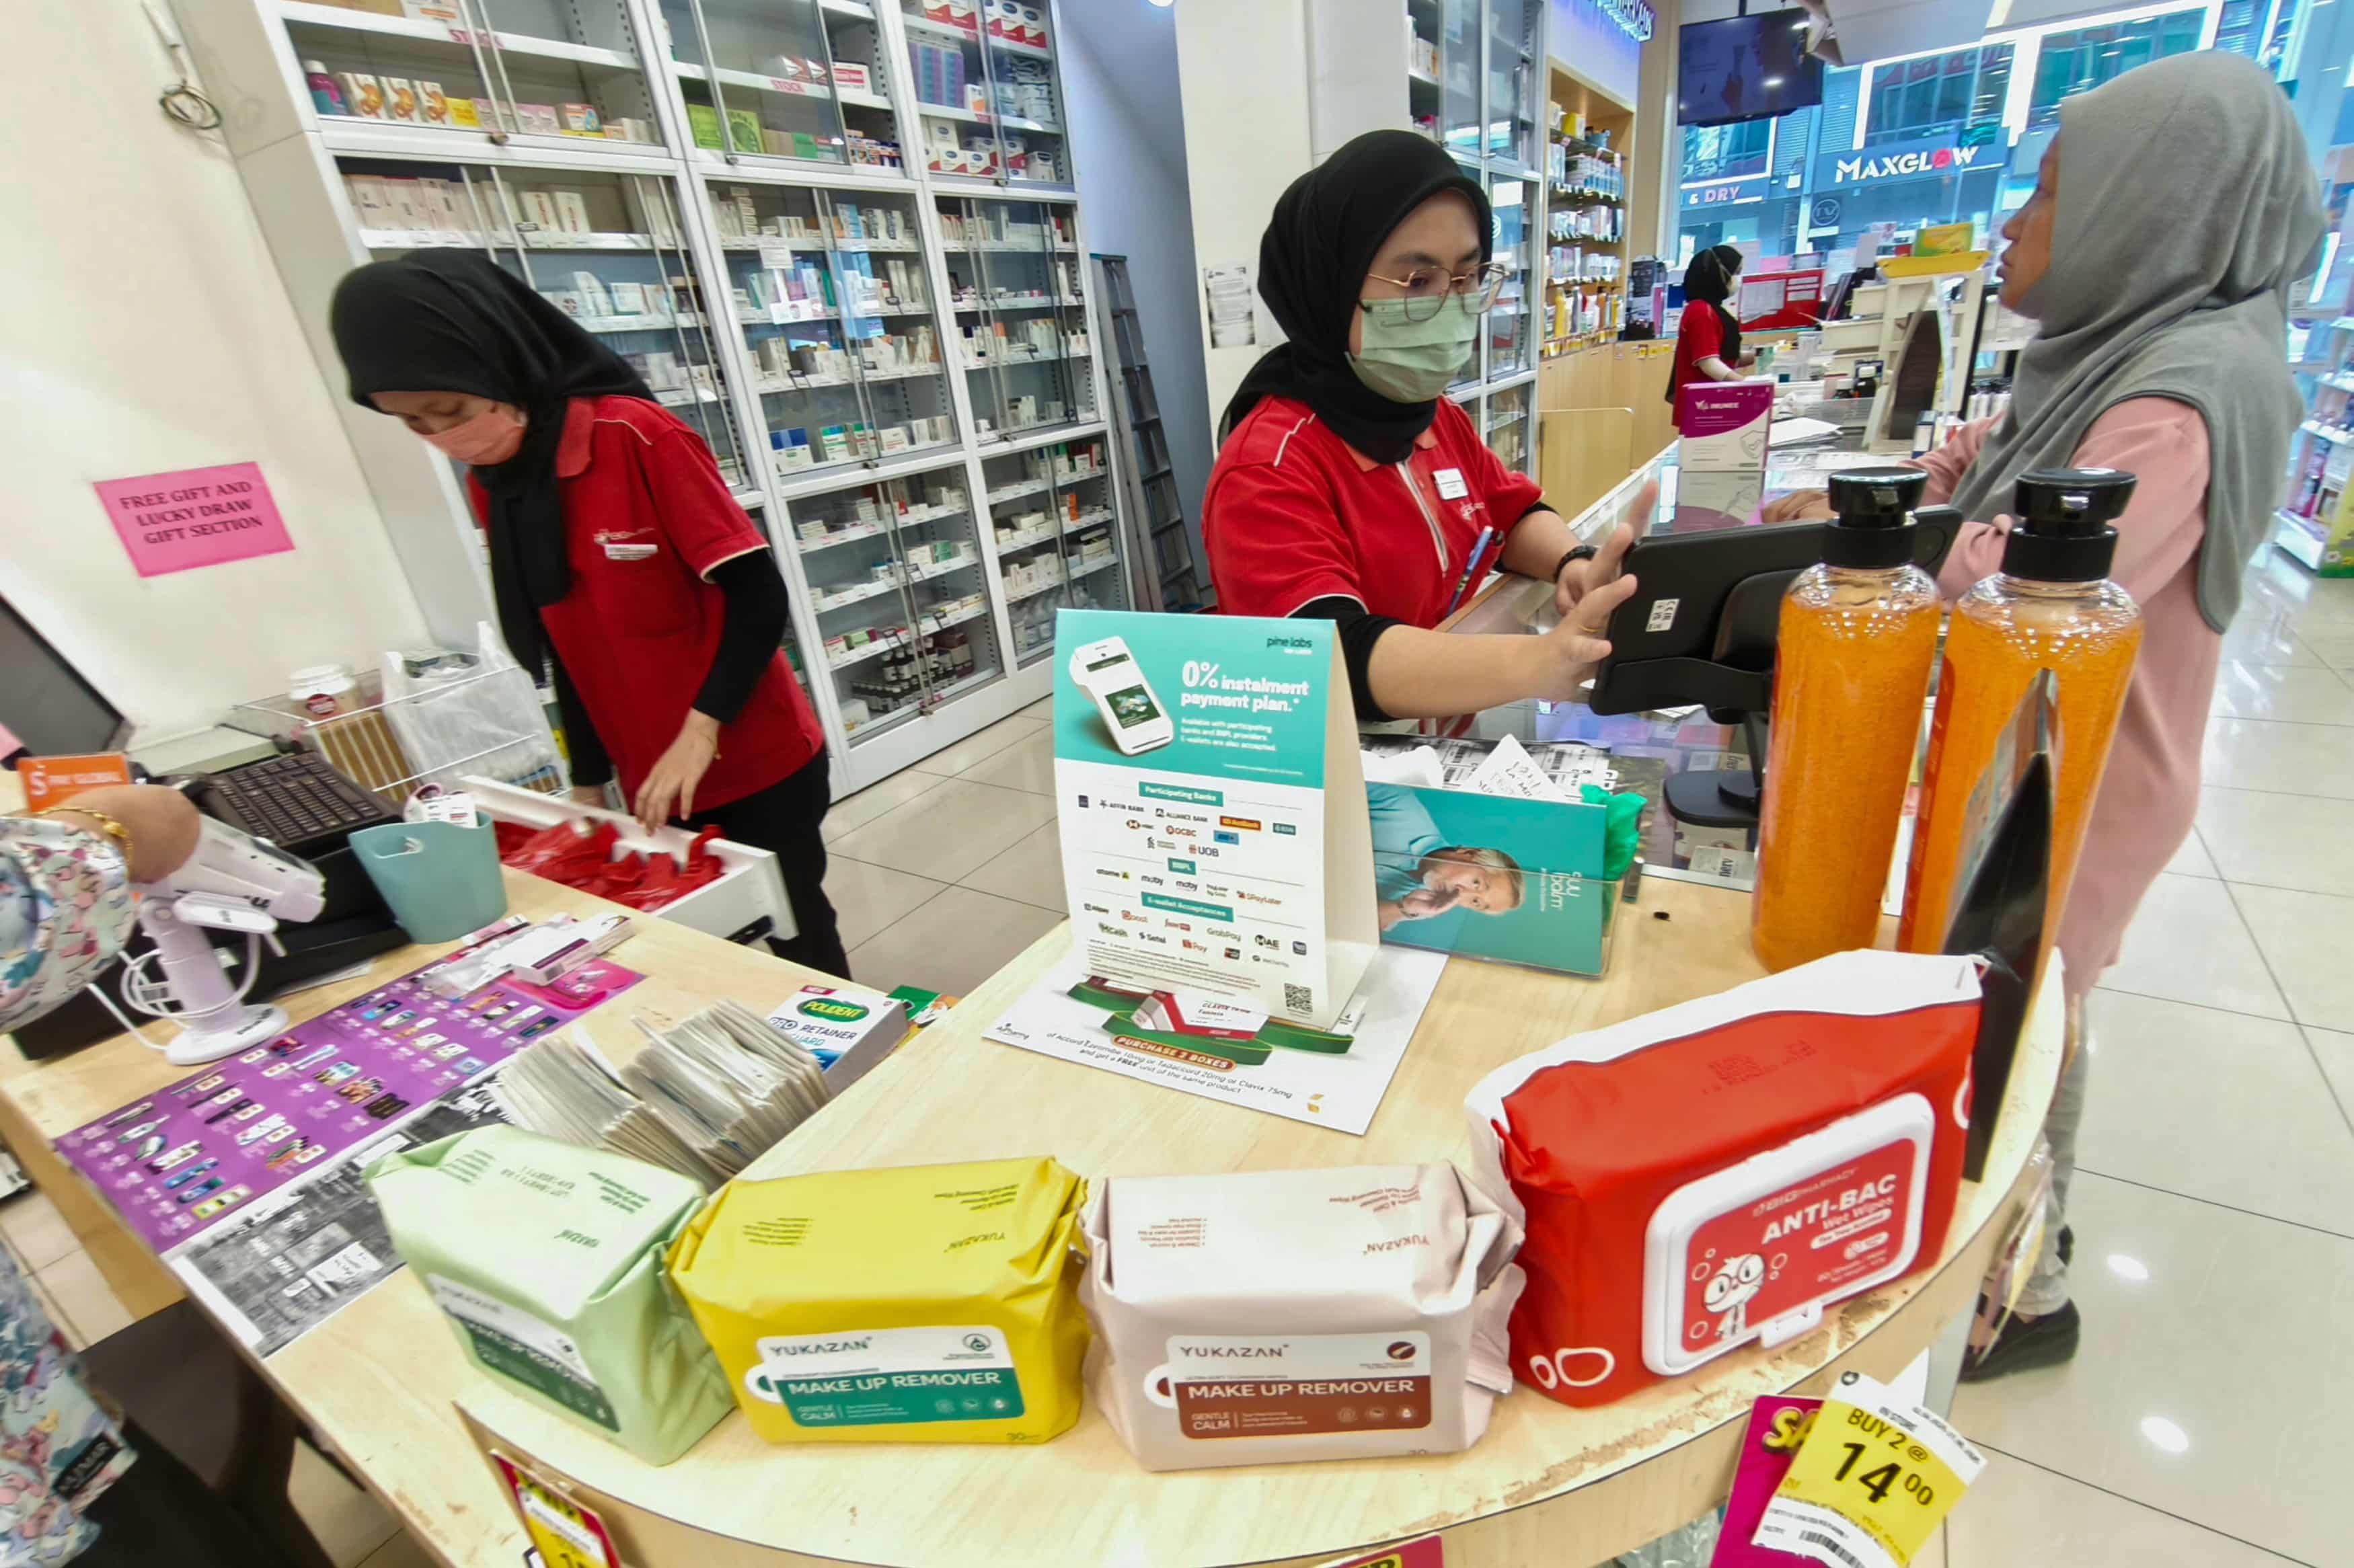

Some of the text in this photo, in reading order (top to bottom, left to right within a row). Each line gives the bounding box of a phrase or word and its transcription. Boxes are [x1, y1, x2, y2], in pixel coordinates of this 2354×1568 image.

[1835, 146, 1979, 183] MAXGLOW
[1704, 186, 1740, 204] DRY
[119, 481, 252, 510] FREE GIFT AND
[135, 499, 252, 526] LUCKY DRAW
[143, 516, 263, 544] GIFT SECTION
[1266, 637, 1312, 648] pine labs
[1182, 660, 1309, 695] 0% instalment
[1180, 692, 1250, 709] payment
[1175, 828, 1197, 837] OCBC
[1198, 846, 1219, 857] UOB
[803, 1001, 864, 1018] POLIDENT
[800, 1024, 858, 1040] RETAINER
[1117, 1036, 1176, 1058] PURCHASE
[1188, 1052, 1229, 1069] BOXES
[1116, 1056, 1139, 1068] FREE
[1207, 1079, 1242, 1094] product
[1761, 1174, 1897, 1245] ANTI-BAC
[1823, 1212, 1850, 1230] Wet
[1852, 1196, 1895, 1218] Wipes
[1366, 1234, 1430, 1253] YUKAZAN
[769, 1339, 870, 1357] YUKAZAN
[1180, 1345, 1283, 1358] YUKAZAN
[788, 1379, 853, 1396] MAKE
[857, 1376, 888, 1391] UP
[892, 1372, 1003, 1388] REMOVER
[1188, 1379, 1416, 1399] MAKE UP REMOVER
[1192, 1419, 1231, 1430] CALM
[1848, 1408, 1889, 1438] BUY
[1889, 1432, 1907, 1450] 2
[1907, 1446, 1928, 1462] @
[1834, 1442, 1902, 1503] 14
